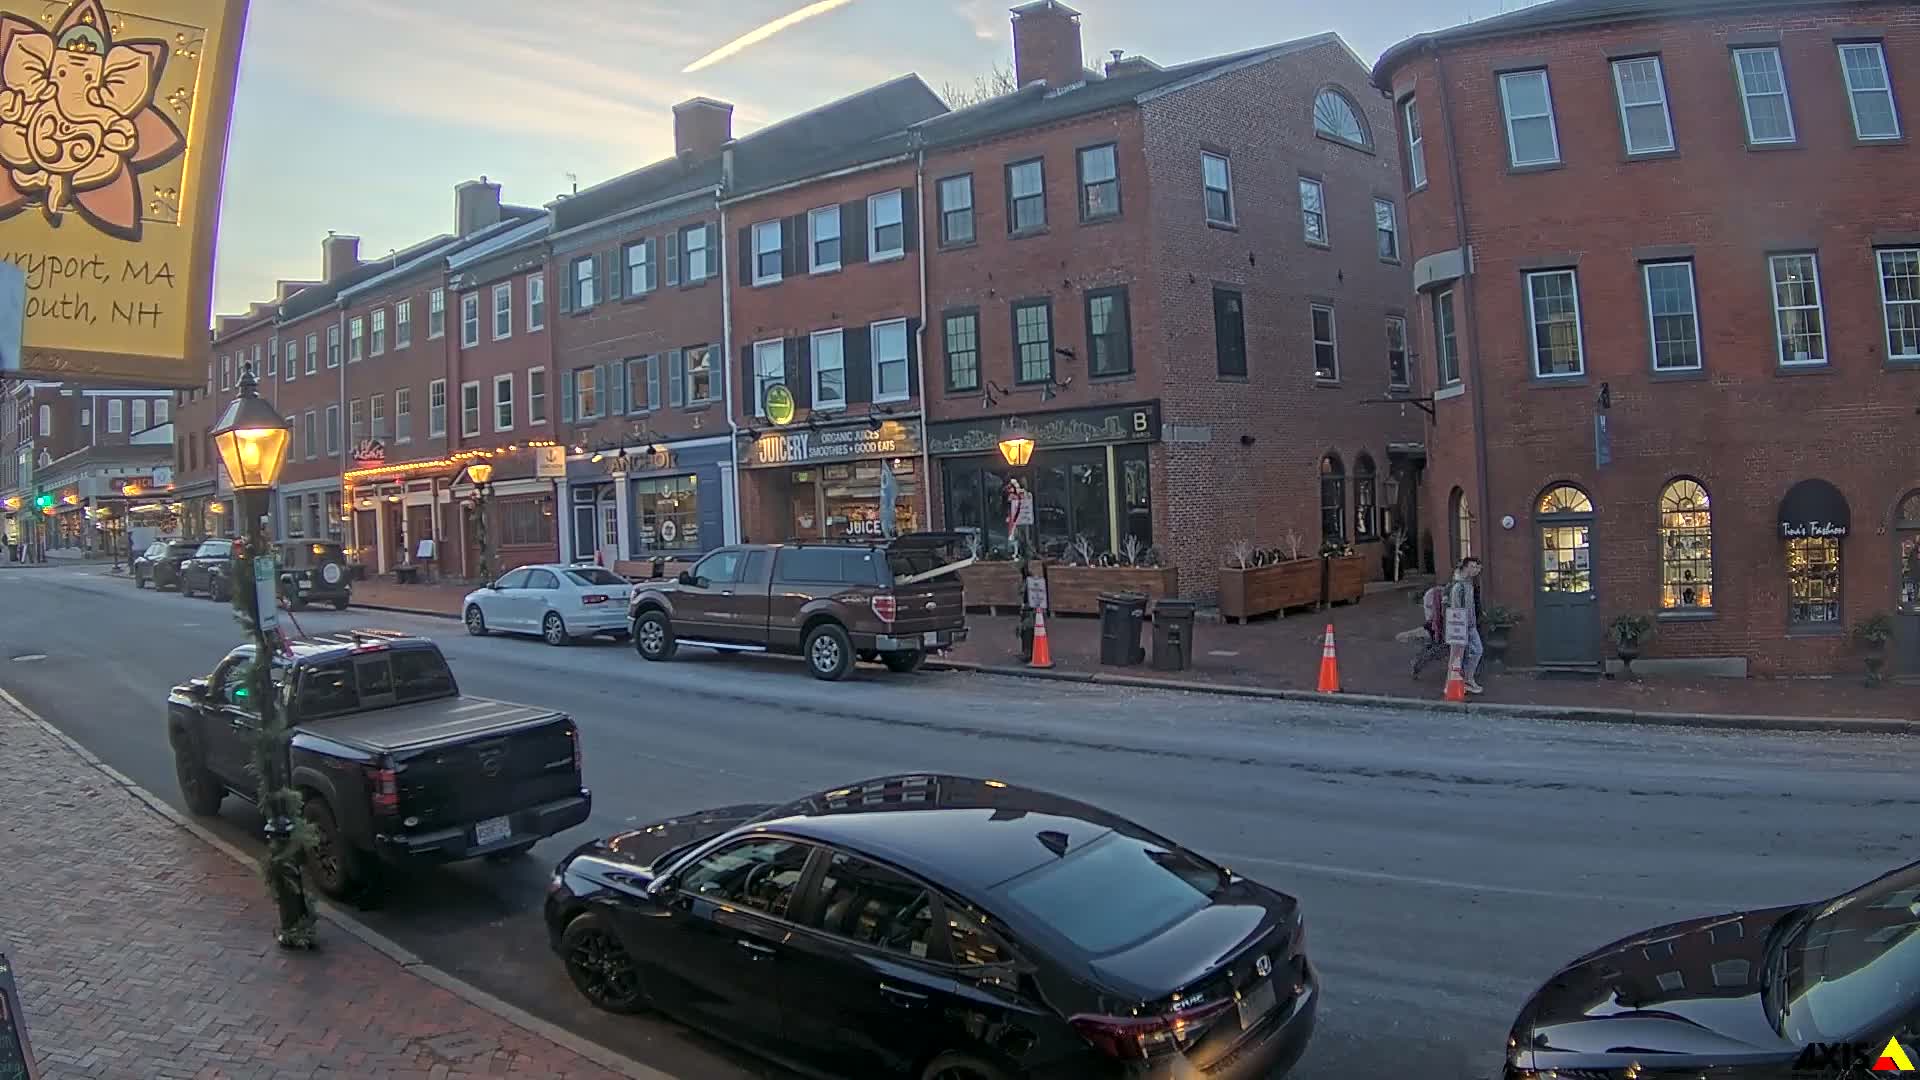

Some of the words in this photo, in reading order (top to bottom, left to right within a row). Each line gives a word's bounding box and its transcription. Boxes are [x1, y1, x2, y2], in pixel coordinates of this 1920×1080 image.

[121, 259, 176, 288] MA
[111, 299, 164, 329] NH
[1133, 412, 1147, 431] B
[821, 432, 853, 444] ORGANIC
[854, 429, 880, 441] JUICES
[758, 434, 809, 463] JUICERY
[808, 444, 849, 457] SMOOTHIES
[854, 442, 877, 453] GOOD
[877, 440, 896, 452] EATS
[846, 520, 881, 536] JUICE
